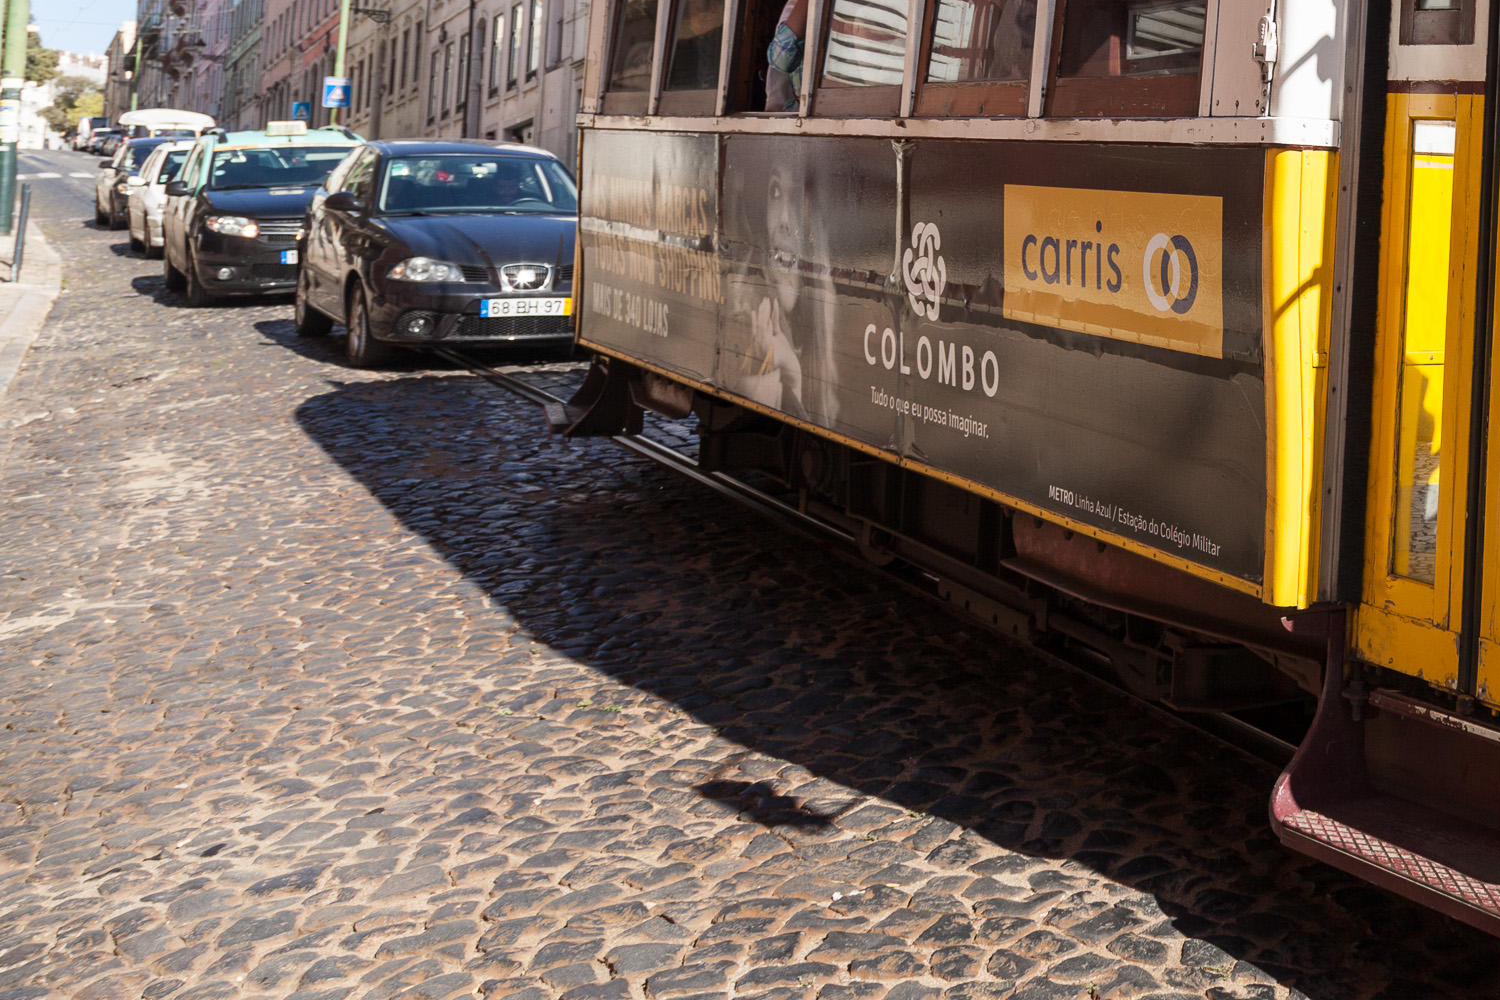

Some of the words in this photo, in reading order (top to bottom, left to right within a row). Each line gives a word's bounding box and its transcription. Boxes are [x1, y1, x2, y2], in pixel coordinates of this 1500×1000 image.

[655, 183, 707, 238] MARCAS
[1021, 220, 1122, 293] carris
[592, 281, 612, 317] MAIS
[613, 287, 623, 321] DE
[643, 297, 669, 338] LOJAS
[864, 323, 999, 397] COLOMBO
[870, 385, 889, 408] Tudo
[889, 395, 895, 410] o
[895, 397, 910, 417] que
[911, 402, 922, 418] eu
[923, 405, 947, 425] possa
[948, 408, 989, 439] imaginar.
[1048, 484, 1074, 506] METRO
[1074, 493, 1094, 513] Linha
[1095, 500, 1112, 520] Azul
[1112, 506, 1118, 522] /
[1118, 507, 1148, 533] Estação
[1148, 518, 1159, 536] do
[1160, 522, 1191, 549] Colégio
[1192, 533, 1221, 557] Militar
